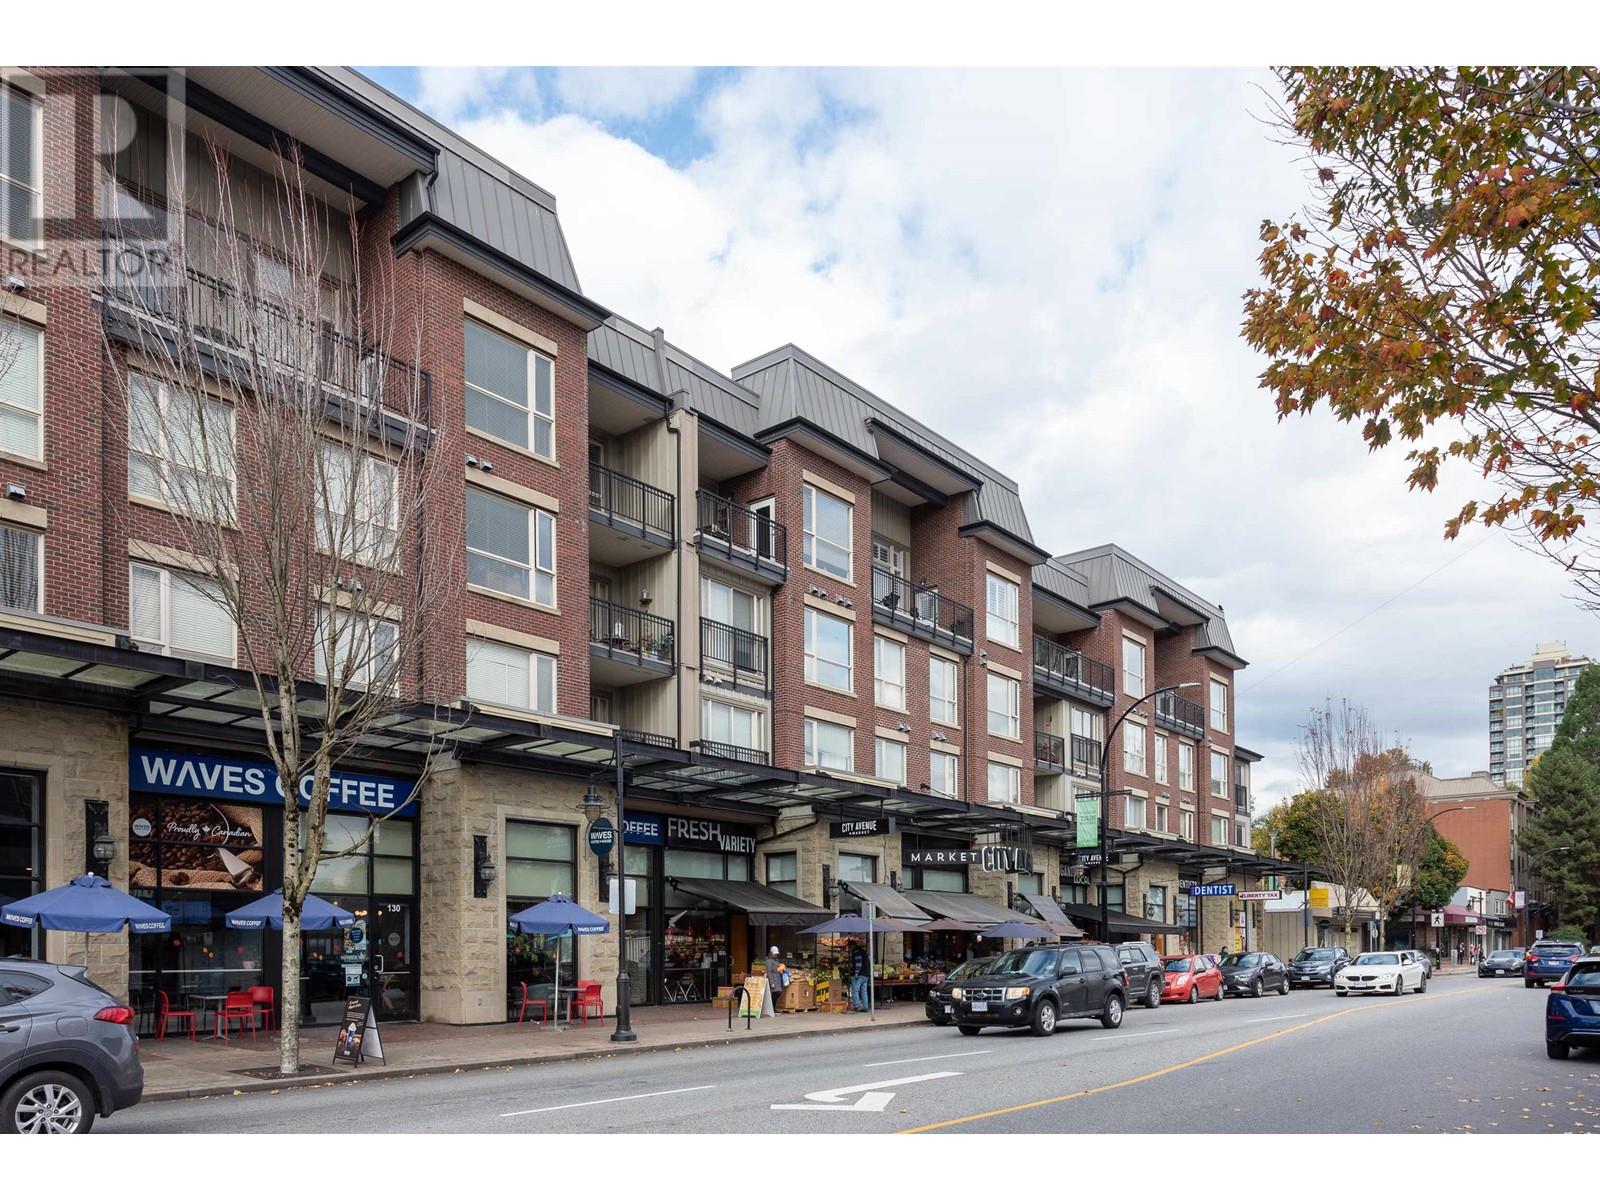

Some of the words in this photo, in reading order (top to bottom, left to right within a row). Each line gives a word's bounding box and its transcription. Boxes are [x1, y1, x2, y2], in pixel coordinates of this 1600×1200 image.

[140, 755, 265, 796] WAVES
[167, 821, 201, 840] Proudly
[211, 825, 252, 838] Canadian
[668, 817, 720, 842] FRESH
[842, 823, 854, 833] CITY
[855, 820, 877, 831] AVENUE
[591, 831, 612, 840] WAVES
[719, 835, 756, 854] VARIETY
[911, 852, 977, 862] MARKET
[1194, 885, 1233, 895] DENTIST
[388, 904, 401, 913] 130
